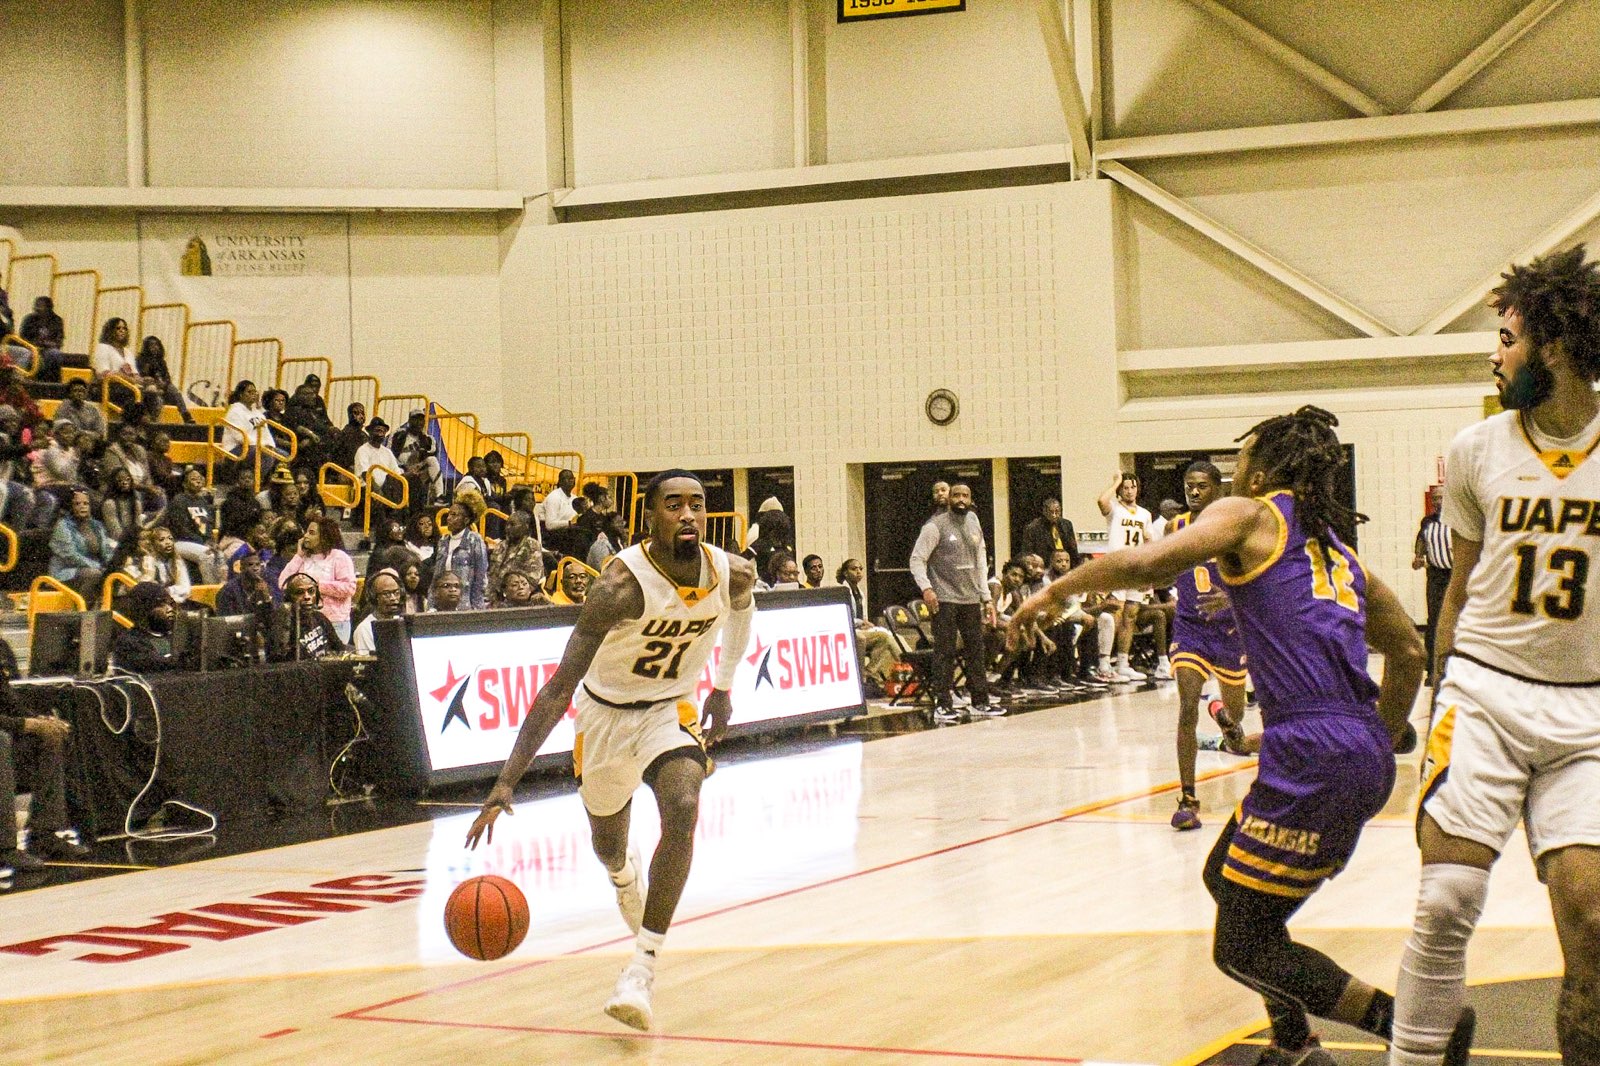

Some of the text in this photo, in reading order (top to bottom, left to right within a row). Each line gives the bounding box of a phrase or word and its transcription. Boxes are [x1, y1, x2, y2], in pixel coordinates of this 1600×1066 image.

[215, 235, 305, 247] UNIVERSITY
[229, 249, 306, 260] ARKANSAS
[236, 263, 265, 272] PINE
[270, 263, 306, 272] BLUFF
[1124, 530, 1140, 547] 14
[1509, 541, 1591, 621] 13
[632, 640, 691, 680] 21
[777, 633, 850, 691] SWAC
[478, 663, 577, 731] SW
[1240, 815, 1321, 855] ARKANSAS
[0, 874, 427, 963] SWAC
